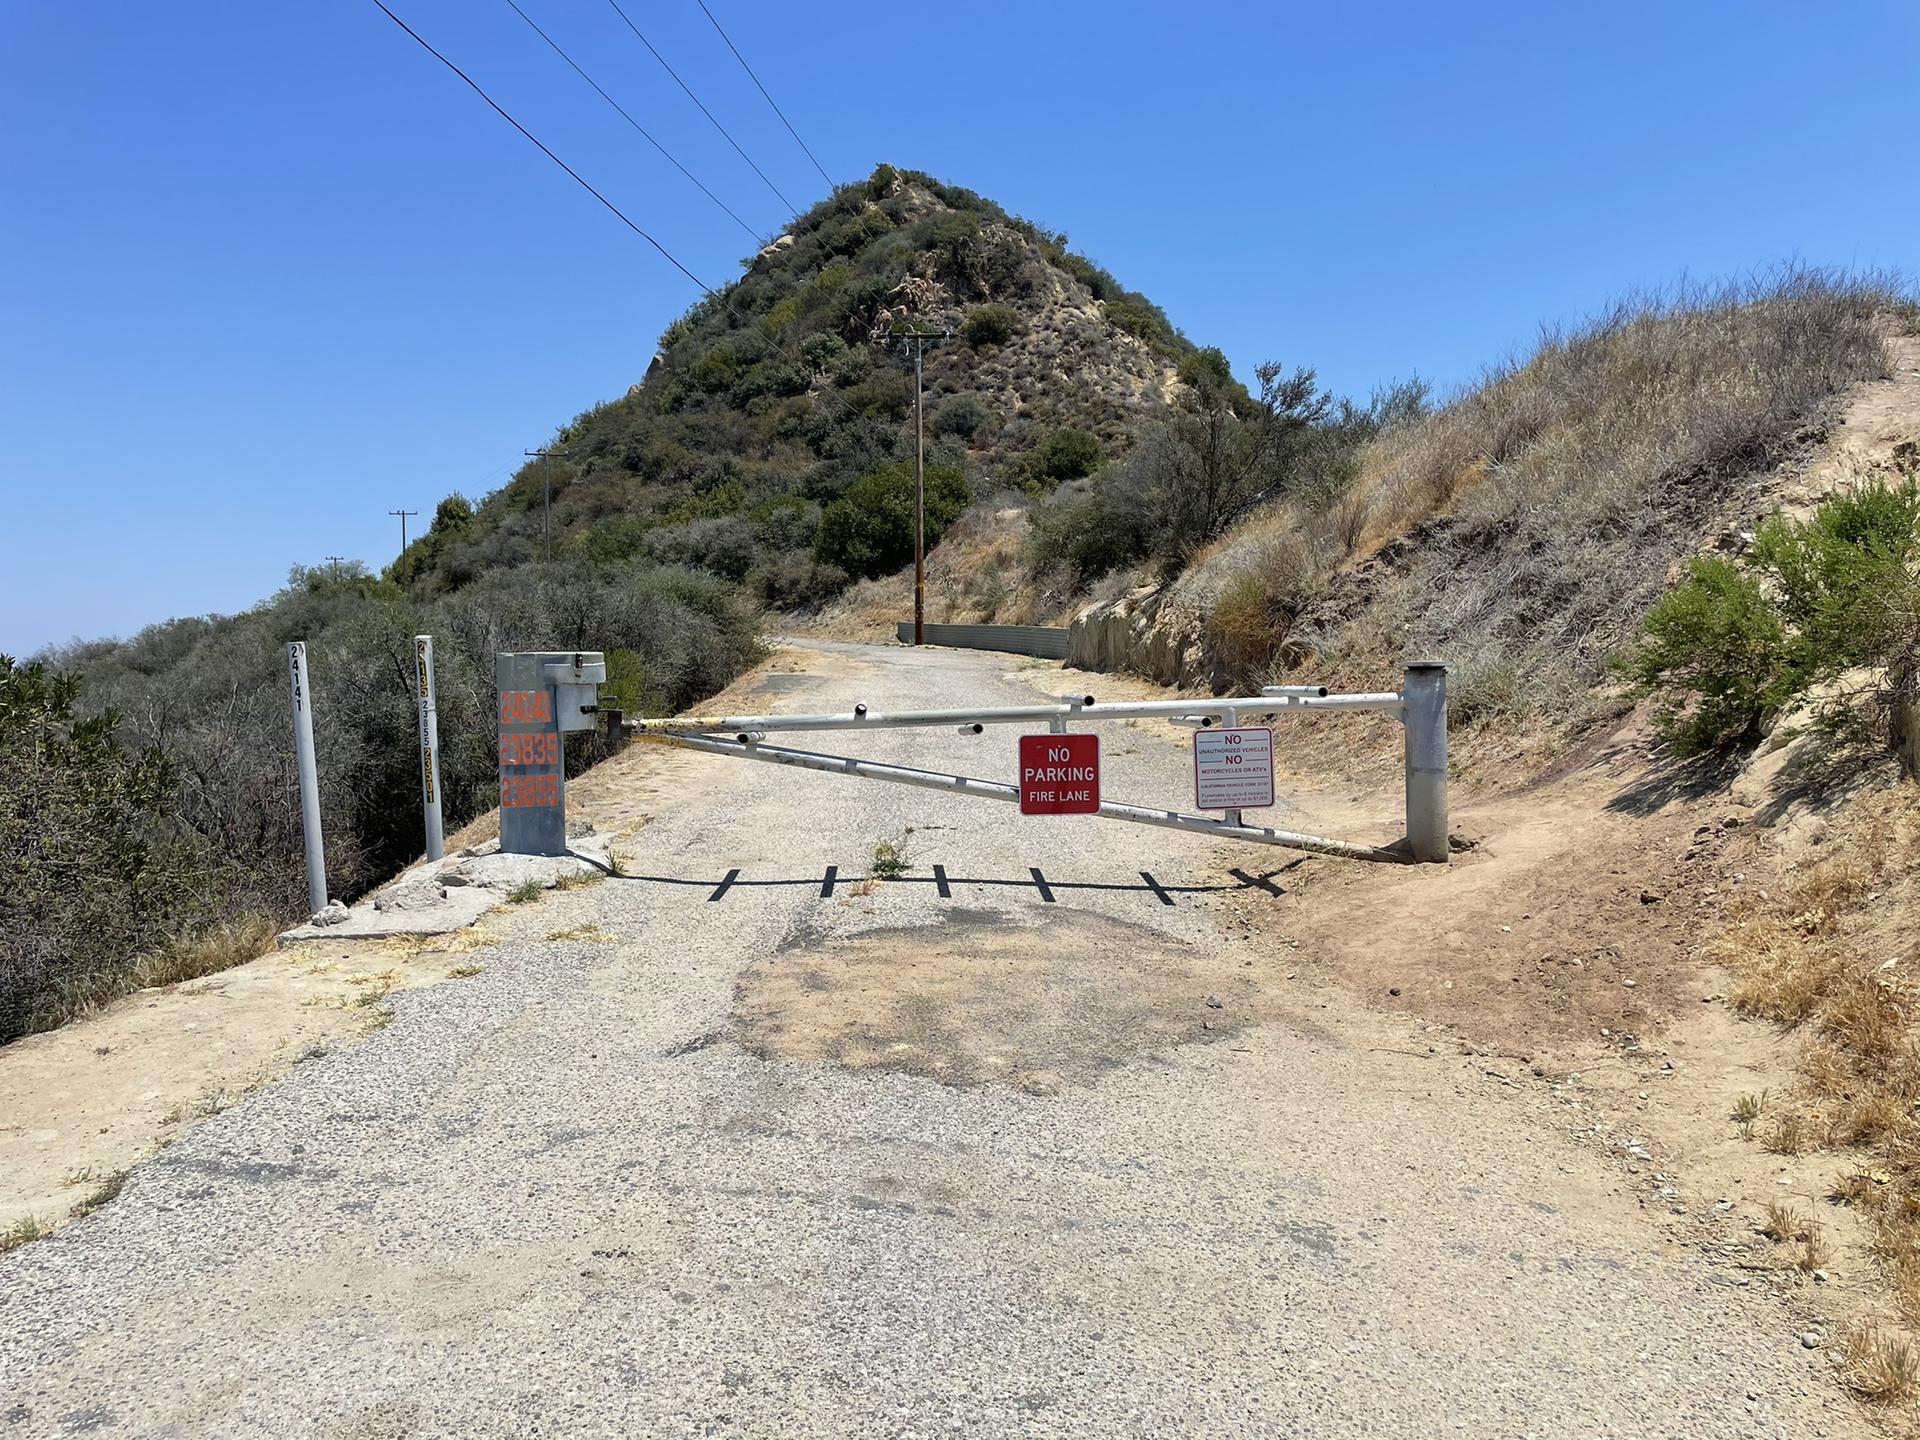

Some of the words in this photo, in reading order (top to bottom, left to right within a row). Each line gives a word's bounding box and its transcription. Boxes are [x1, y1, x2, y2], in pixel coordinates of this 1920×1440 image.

[291, 646, 302, 711] 24141
[1225, 735, 1242, 744] NO
[1048, 748, 1070, 762] NO
[1225, 755, 1242, 765] NO
[424, 748, 434, 803] 23501
[1025, 767, 1095, 782] PARKING
[1029, 791, 1056, 802] FIRE
[1059, 790, 1090, 802] LANE
